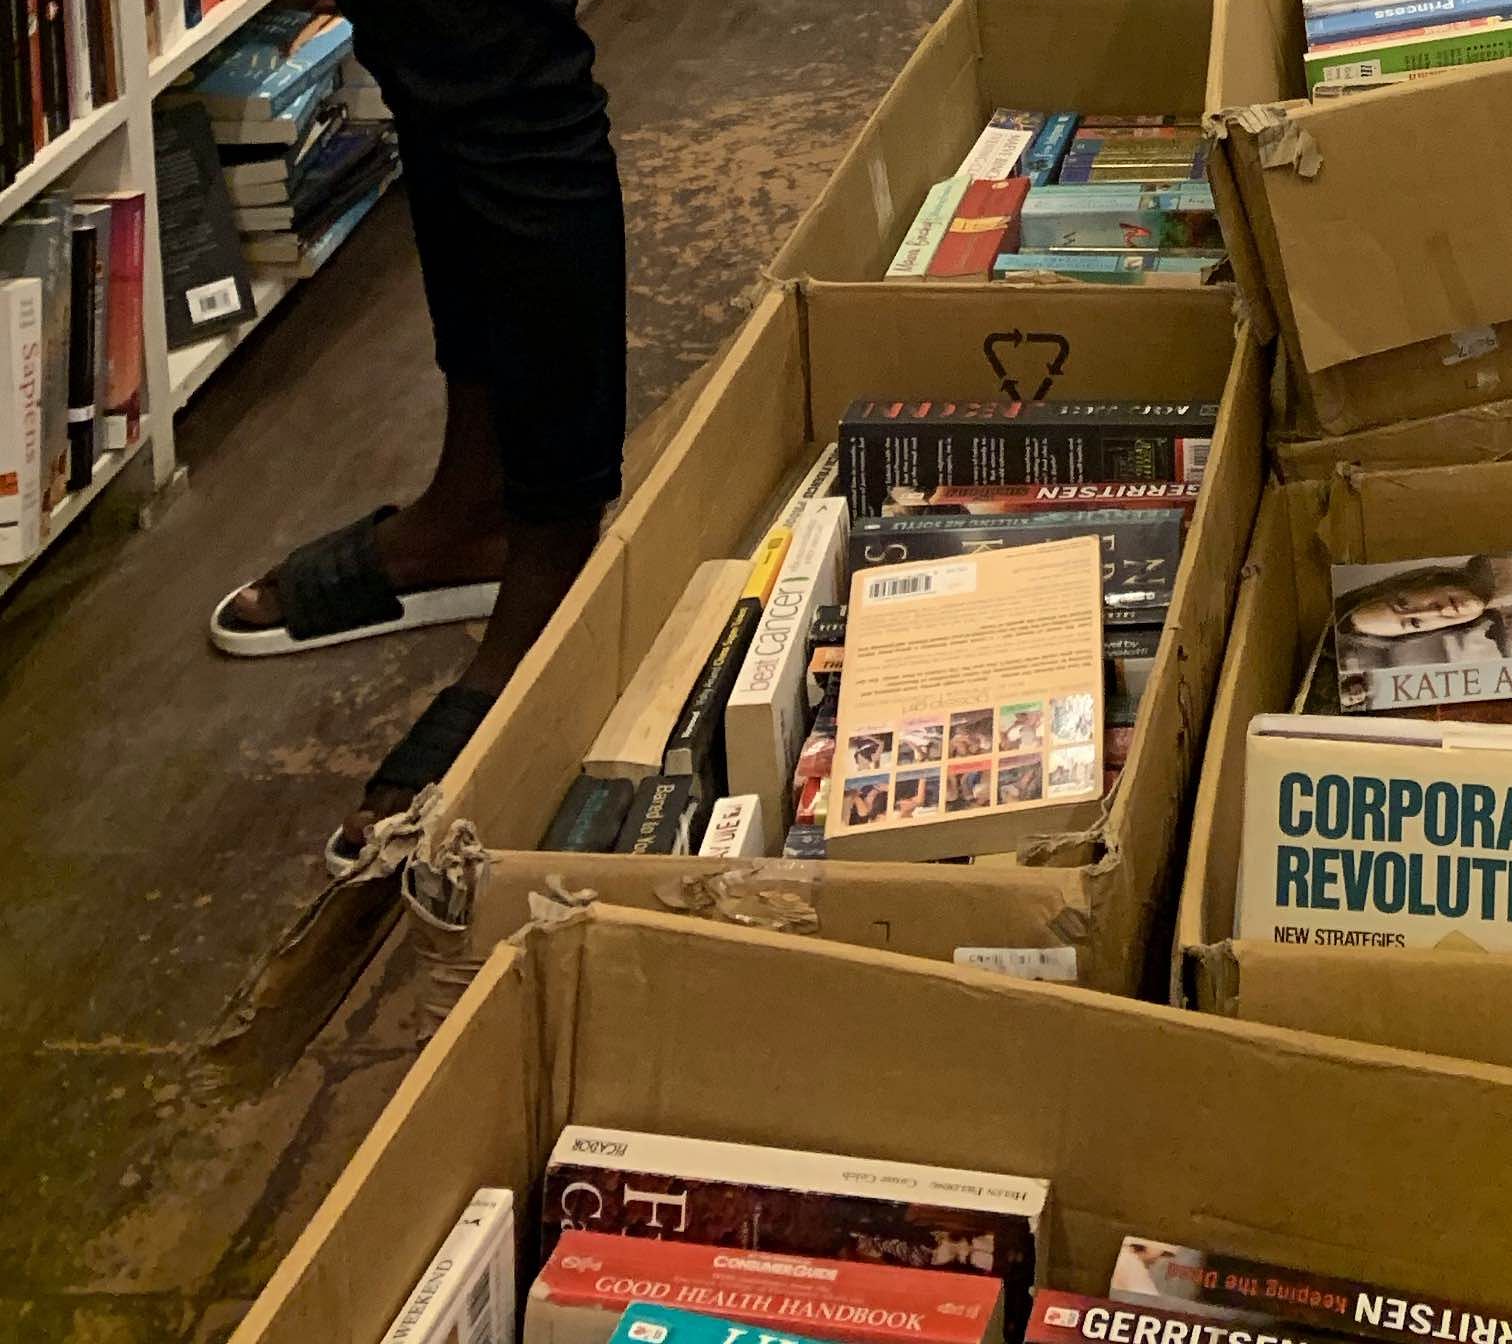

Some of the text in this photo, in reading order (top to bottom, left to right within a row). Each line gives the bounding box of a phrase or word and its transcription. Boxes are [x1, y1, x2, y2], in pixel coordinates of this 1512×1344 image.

[1392, 671, 1482, 703] KATE
[652, 783, 675, 820] Bared
[632, 832, 656, 855] Yo
[1274, 926, 1310, 945] NEW
[594, 1276, 925, 1332] GOOD HEALTH HANDBOOK
